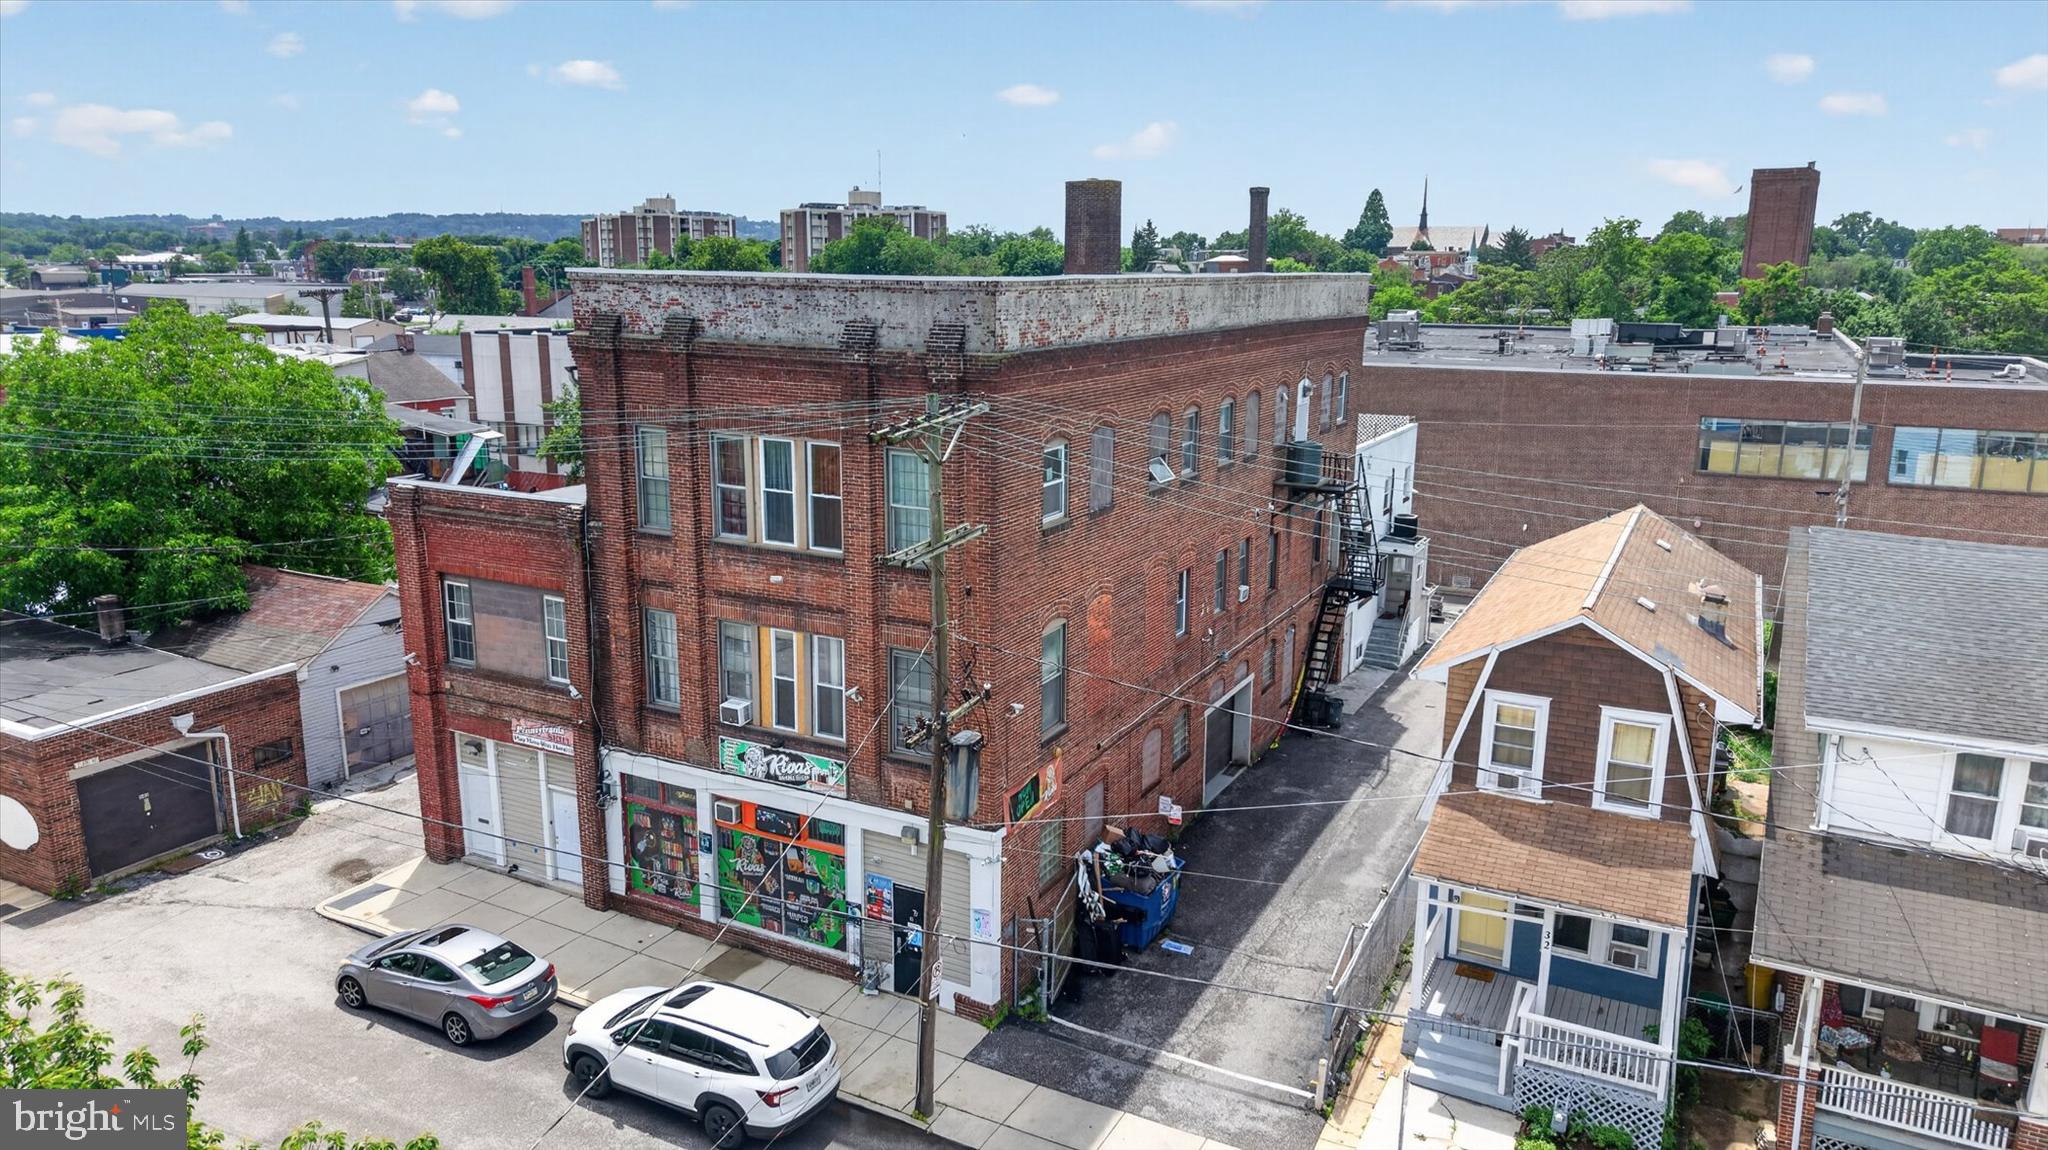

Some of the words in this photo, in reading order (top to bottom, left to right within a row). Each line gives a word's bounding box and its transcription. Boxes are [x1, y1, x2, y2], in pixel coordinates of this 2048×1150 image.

[762, 754, 812, 775] Rivas
[729, 858, 766, 873] Rivas
[1543, 930, 1551, 950] 32
